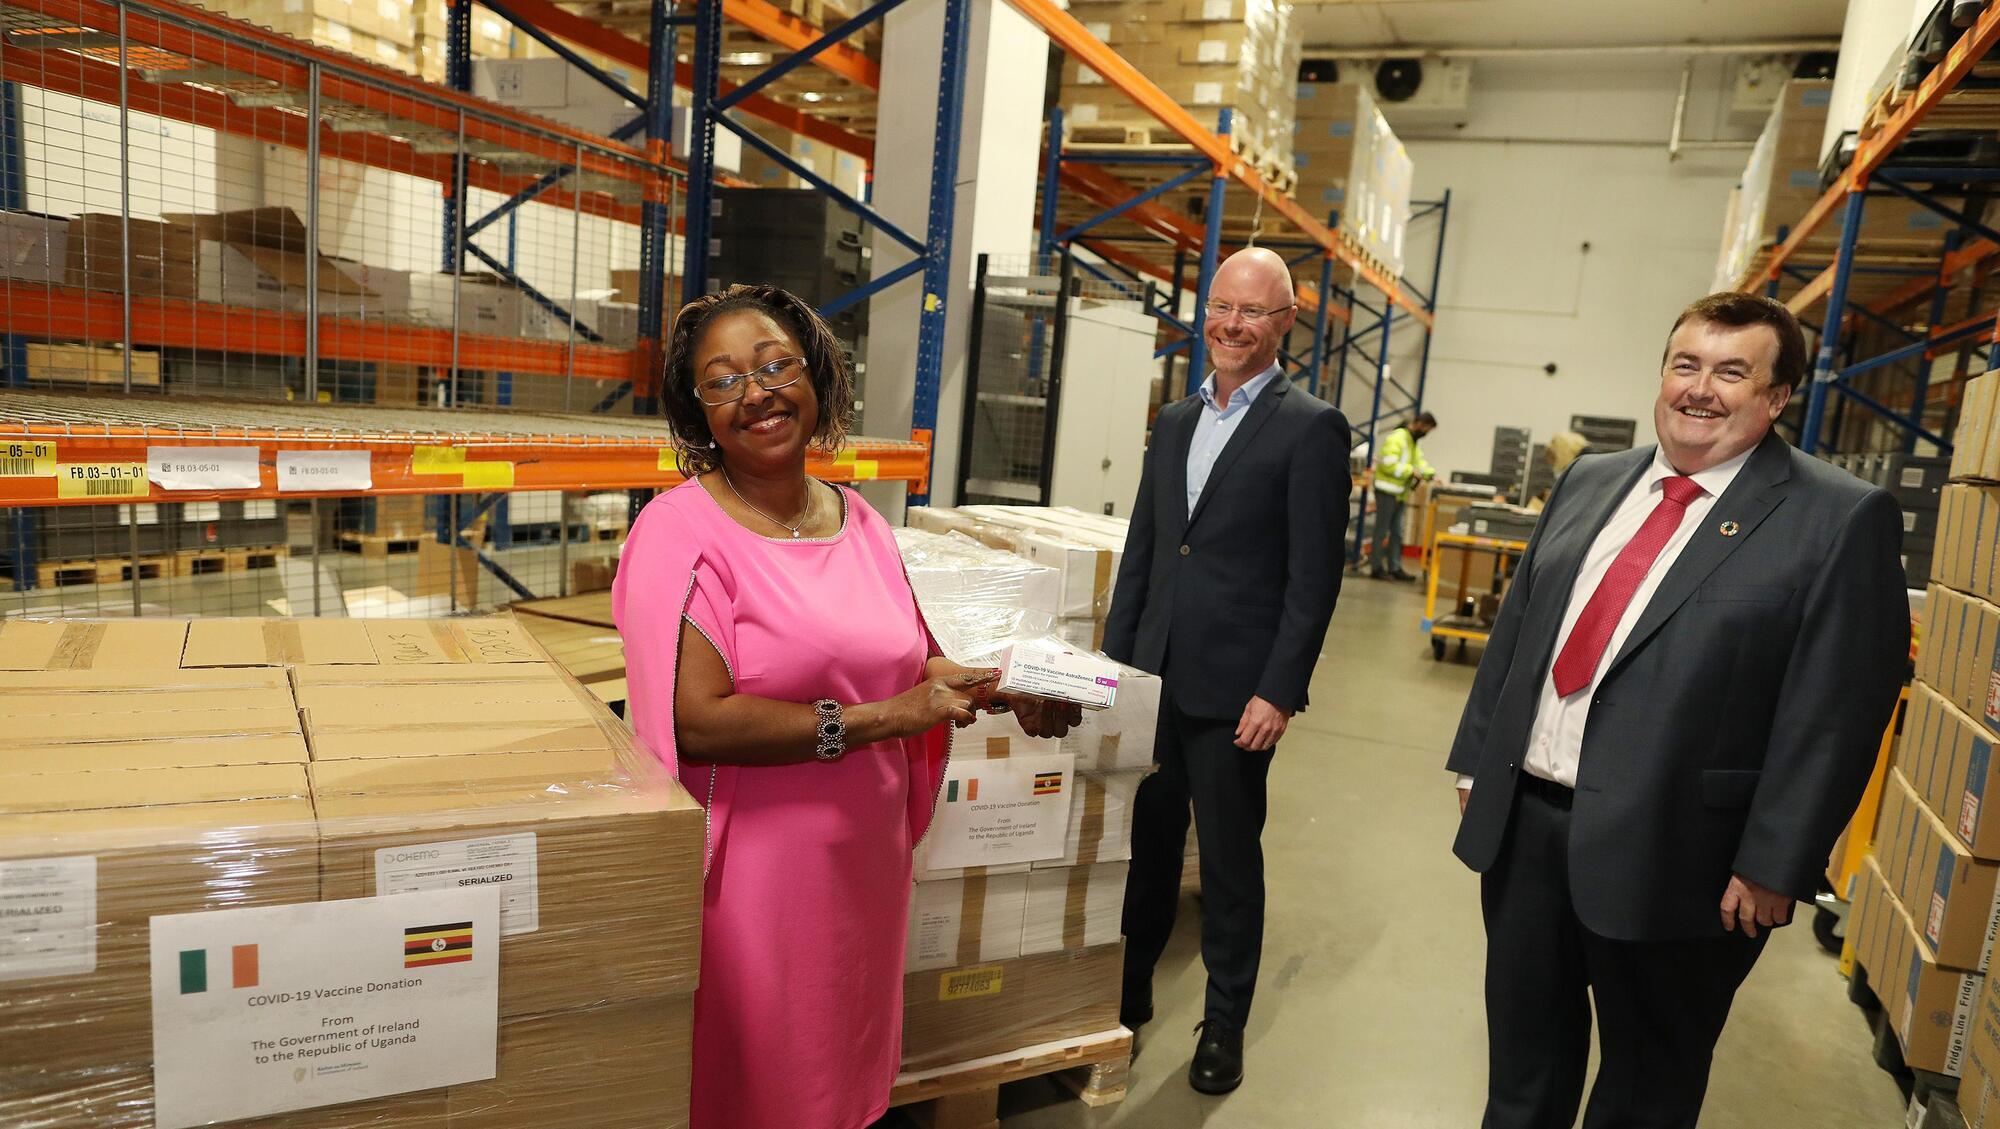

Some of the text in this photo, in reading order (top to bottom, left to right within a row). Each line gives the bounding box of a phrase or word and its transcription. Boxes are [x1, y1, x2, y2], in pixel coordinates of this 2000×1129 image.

[175, 464, 220, 473] FB.03-05-01
[1024, 664, 1046, 673] COVID-19
[1065, 672, 1094, 682] AstraZeneca
[970, 804, 996, 812] COVID-19
[396, 850, 440, 863] CHEMO
[458, 873, 513, 887] SERIALIZED
[248, 977, 422, 1007] COVID-19 Vaccine Donation
[322, 1016, 354, 1027] From
[1947, 973, 1975, 1071] Fridge Line Fridge
[251, 1019, 420, 1051] The Government of Ireland
[255, 1033, 416, 1065] to the Republic of Uganda
